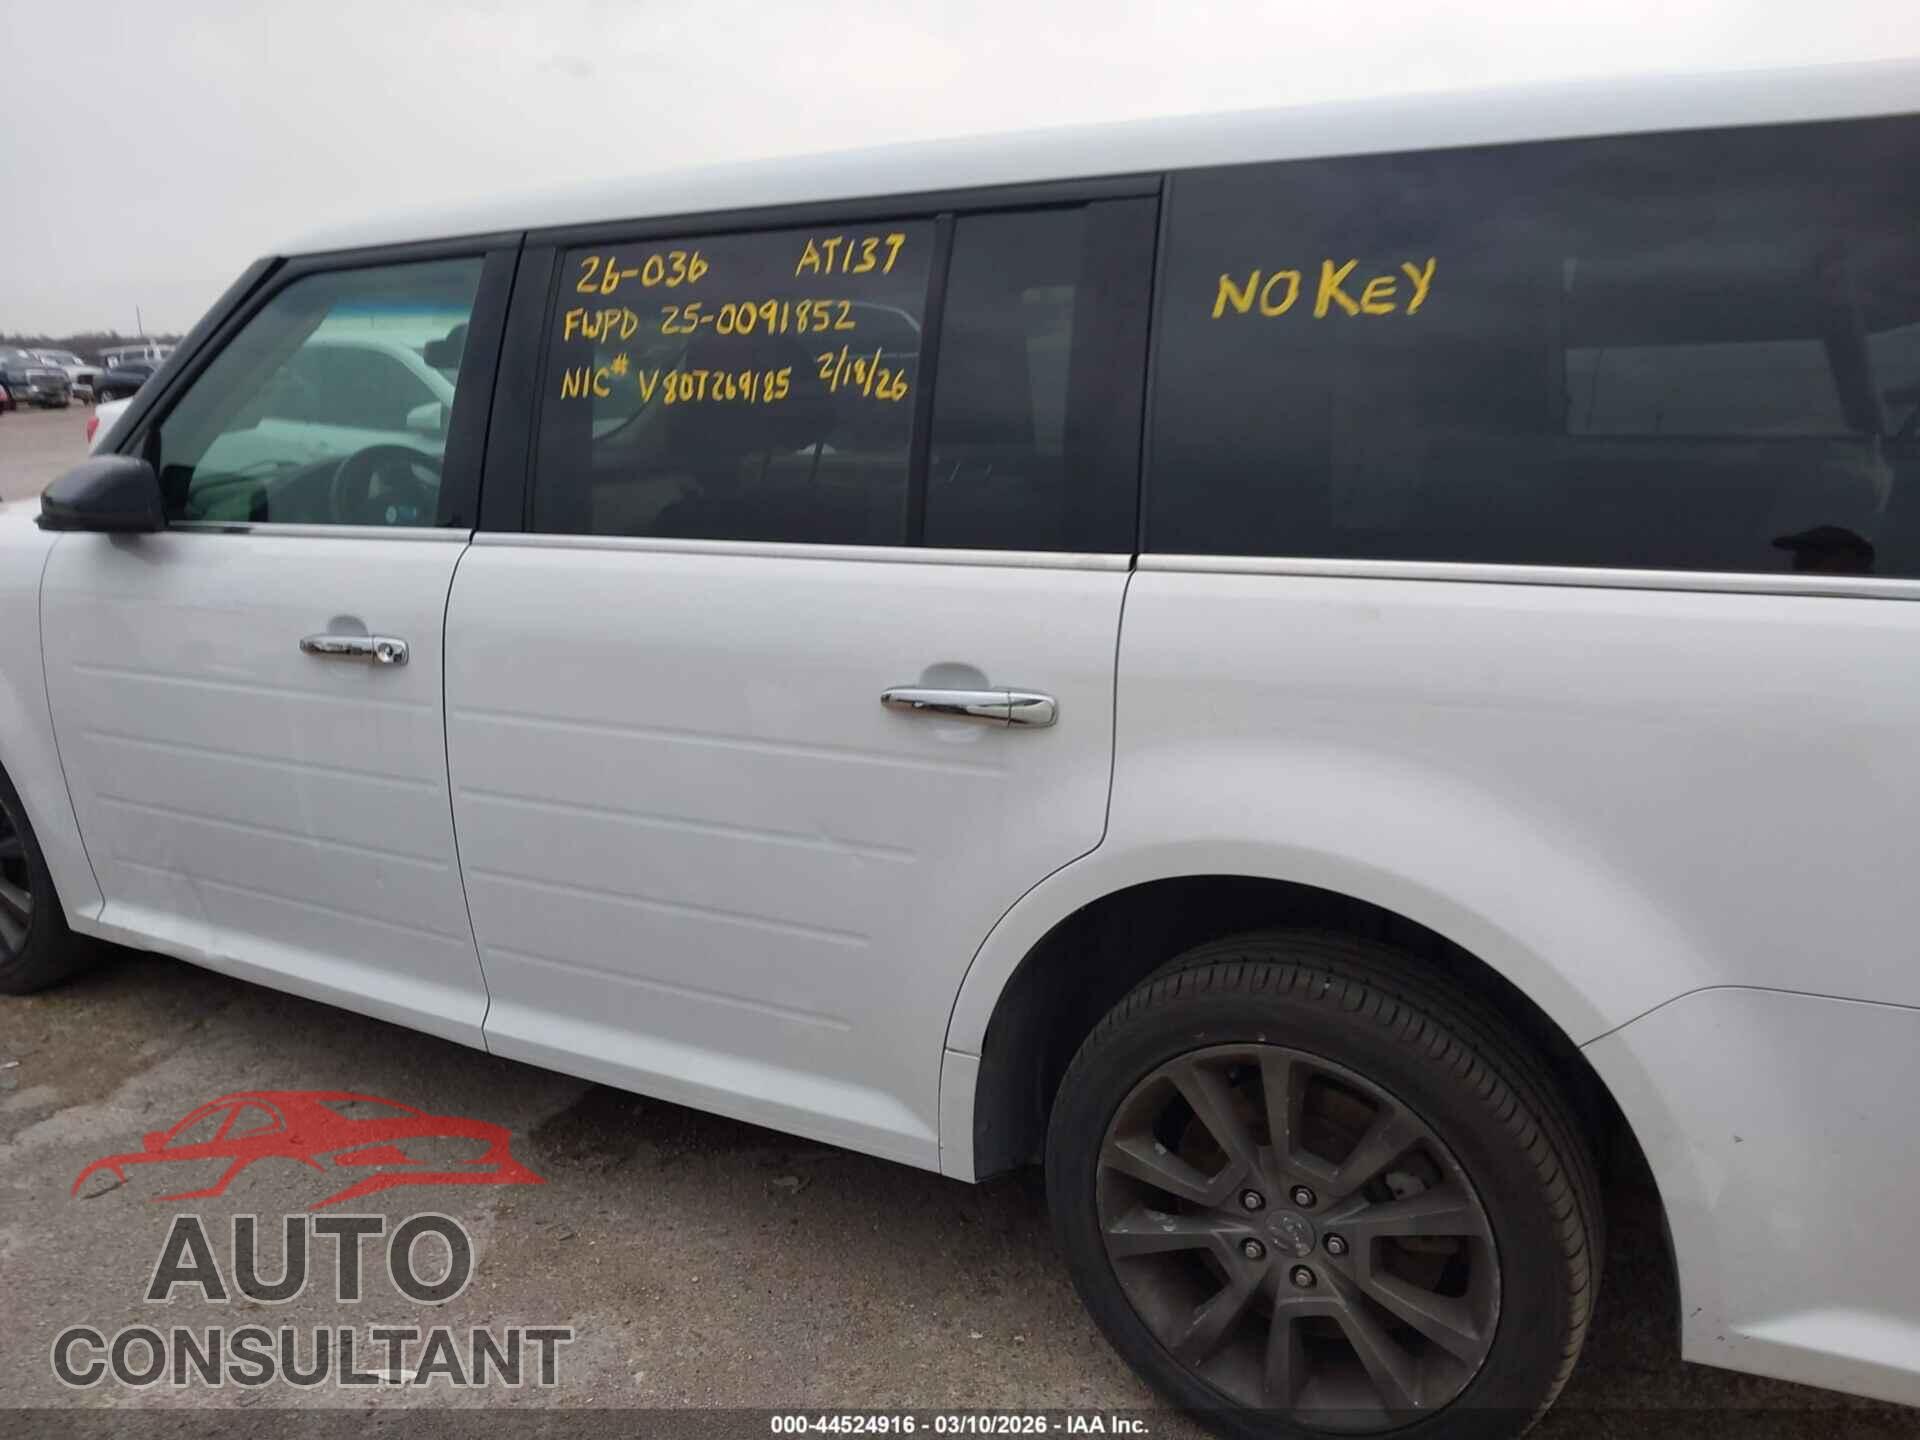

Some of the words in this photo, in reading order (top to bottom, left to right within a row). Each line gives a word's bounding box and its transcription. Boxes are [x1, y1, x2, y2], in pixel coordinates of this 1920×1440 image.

[576, 250, 709, 295] 26-036
[1211, 268, 1301, 319] NO
[563, 306, 640, 344] FWPD
